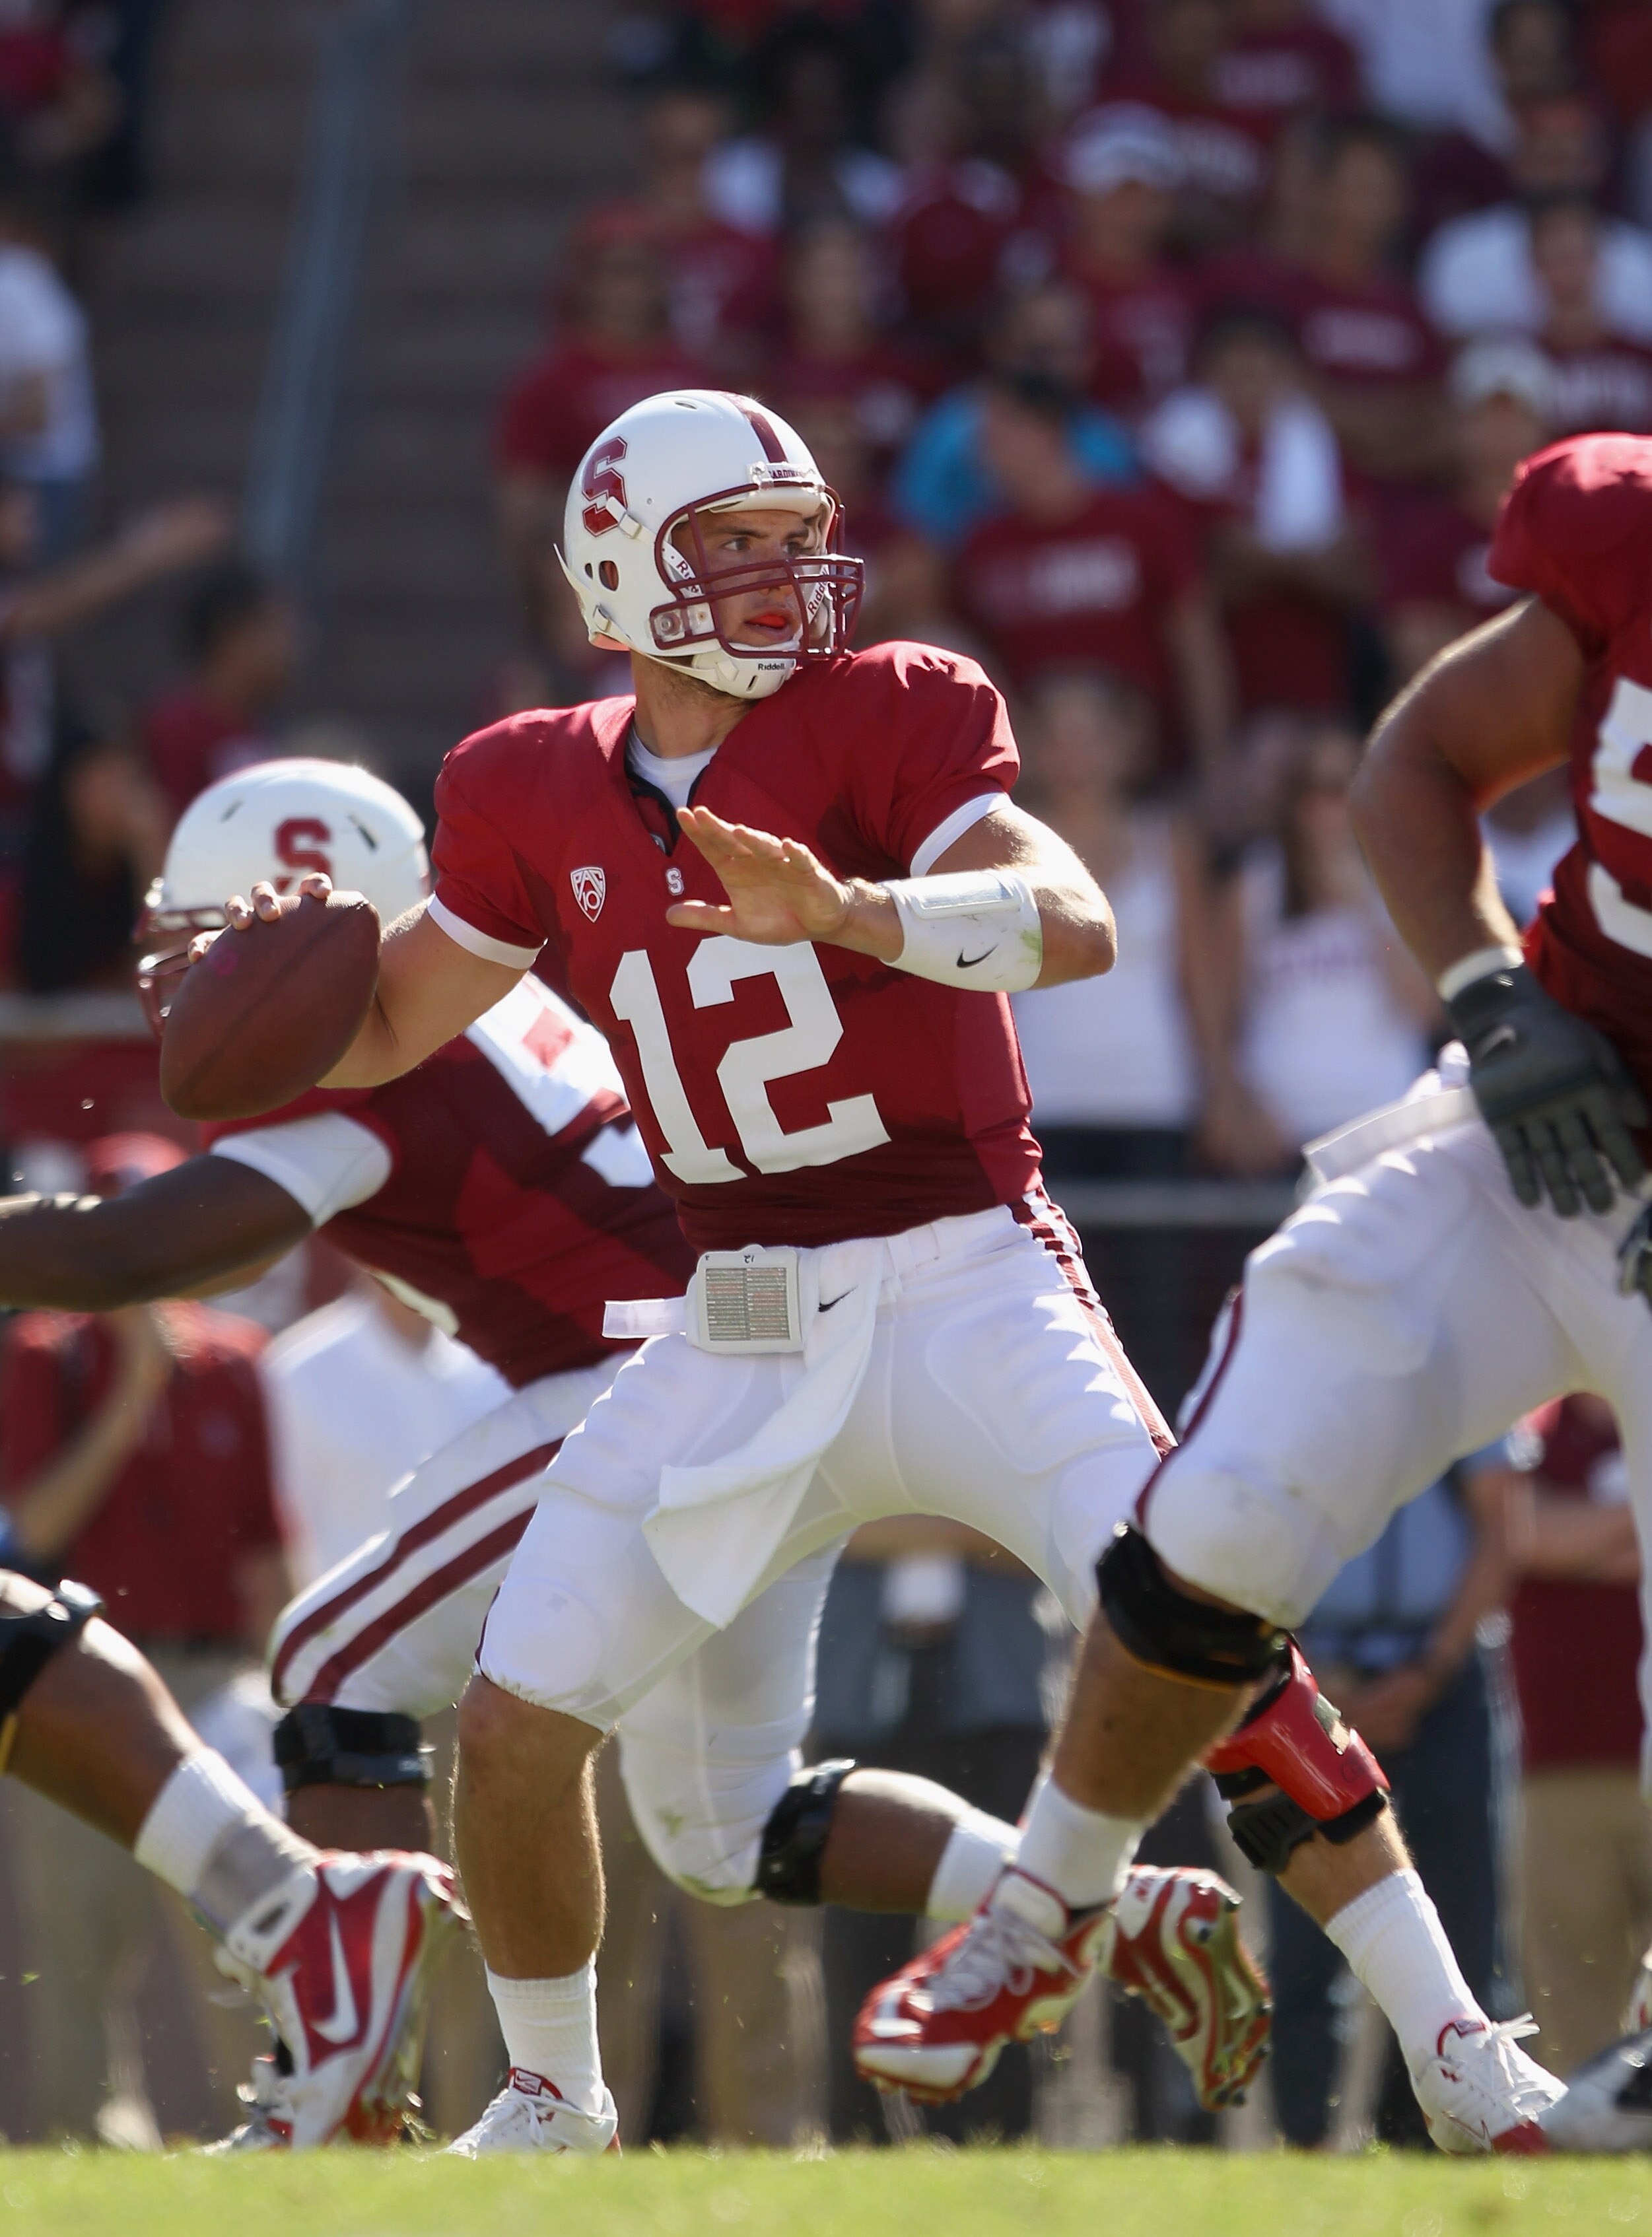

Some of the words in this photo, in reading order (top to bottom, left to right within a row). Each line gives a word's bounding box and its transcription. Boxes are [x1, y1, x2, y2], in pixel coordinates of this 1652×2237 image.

[571, 869, 603, 901] PAC
[666, 868, 684, 896] S
[582, 889, 600, 911] 10
[609, 935, 891, 1185] 12
